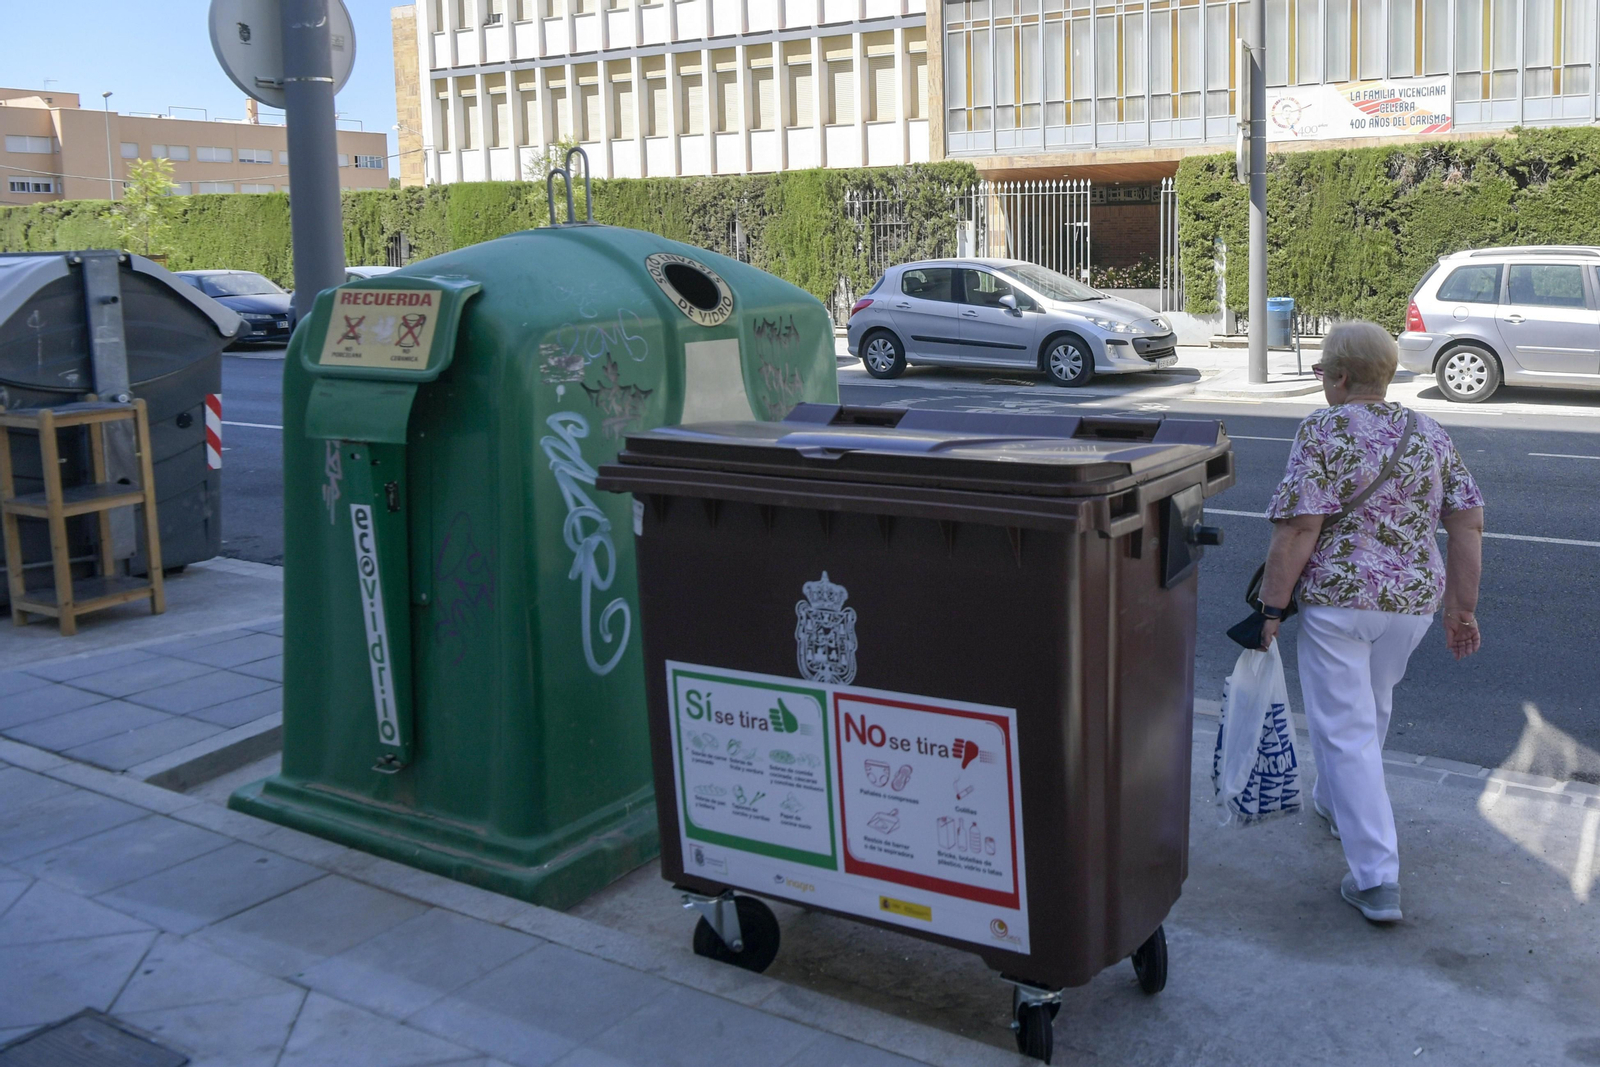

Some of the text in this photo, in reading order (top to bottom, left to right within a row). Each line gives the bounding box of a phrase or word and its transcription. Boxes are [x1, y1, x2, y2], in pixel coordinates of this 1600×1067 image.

[1350, 85, 1447, 102] LA FAMILIA VICENCIANA
[1379, 101, 1416, 114] CELEBRA
[1349, 113, 1447, 129] 400 AÑOS DEL CARISMA
[1298, 125, 1318, 135] 400
[648, 254, 722, 285] SOLO ENVASES
[340, 291, 432, 307] RECUERDA
[678, 296, 732, 324] DE VIDRIO
[685, 688, 769, 732] Sí se tira
[844, 711, 950, 758] No se tira
